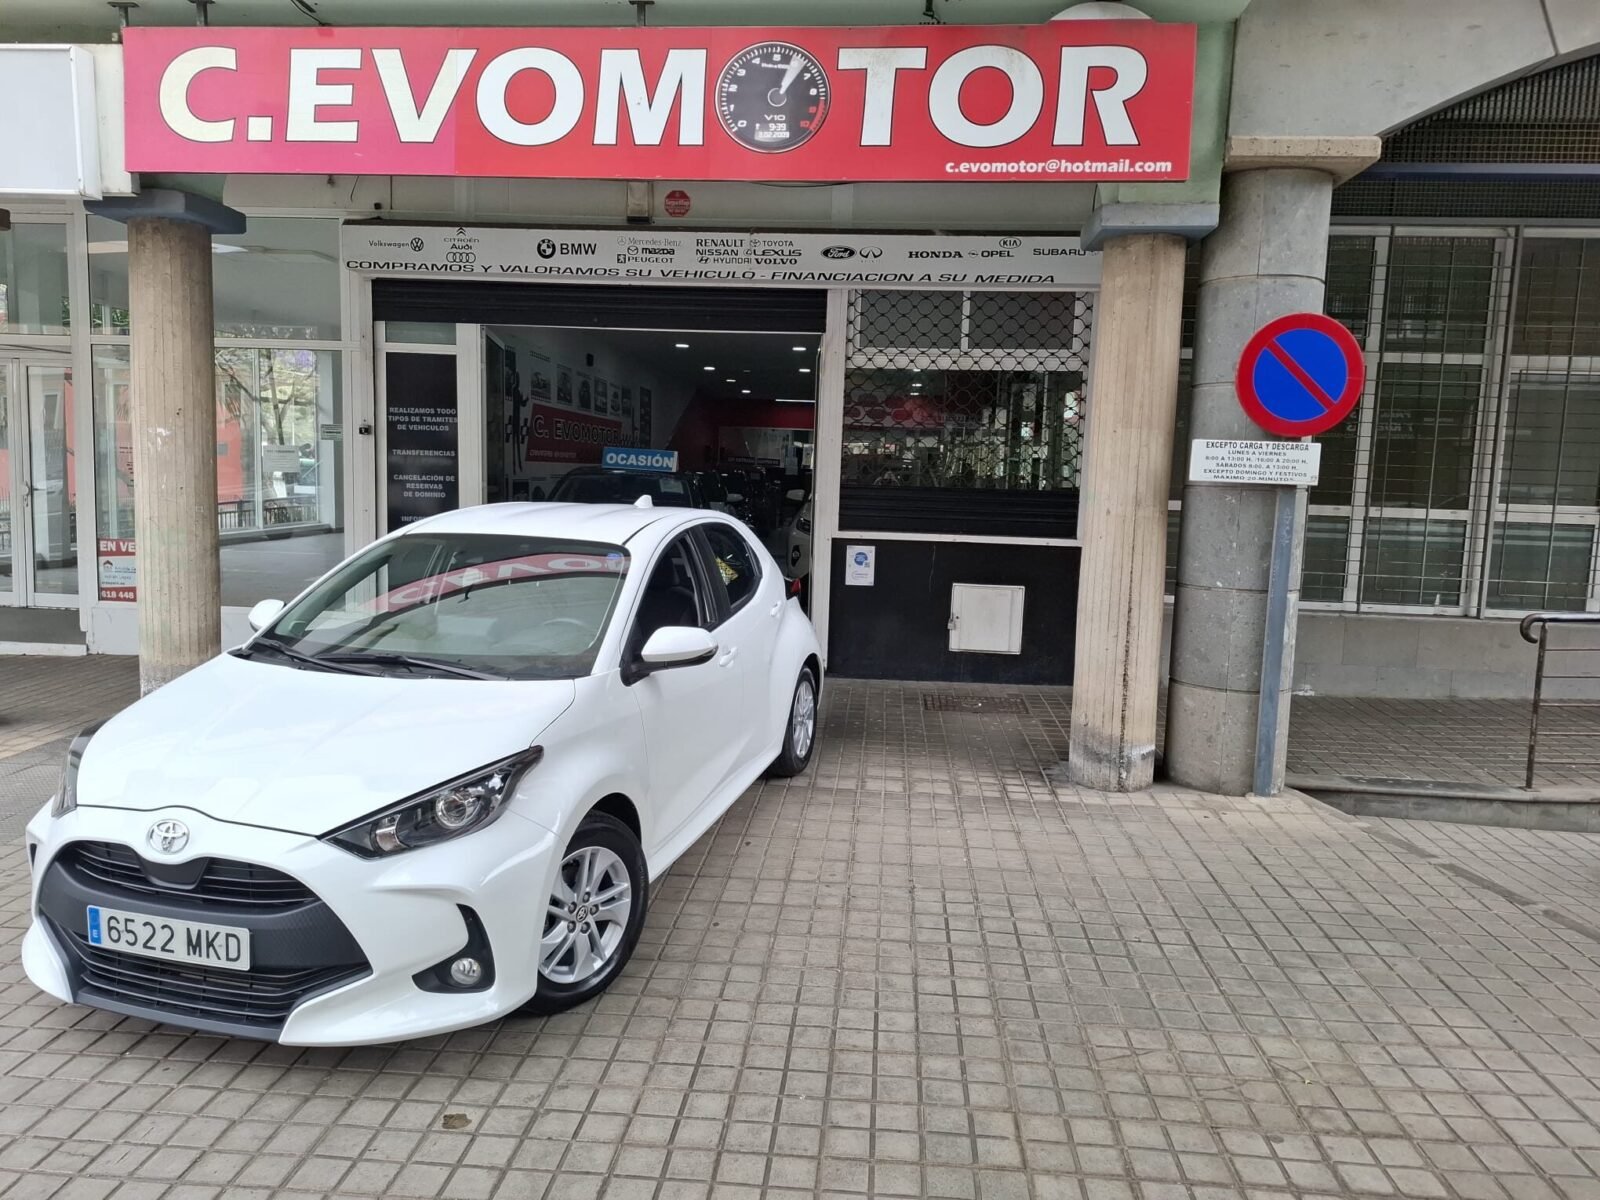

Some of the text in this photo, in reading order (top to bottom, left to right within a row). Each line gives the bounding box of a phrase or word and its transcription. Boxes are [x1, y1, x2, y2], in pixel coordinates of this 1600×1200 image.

[945, 159, 1172, 174] c.evomotor@hotmail.com
[368, 240, 410, 249] Volkswagen
[696, 238, 746, 247] RENAULT
[560, 243, 597, 255] BMW
[826, 248, 851, 259] Ford
[1033, 248, 1086, 256] SUBARU
[908, 250, 964, 259] HONDA
[346, 260, 474, 272] COMPRAMOS
[500, 264, 620, 276] VALORAMOS
[625, 268, 652, 277] SU
[660, 270, 756, 280] VEHICULO
[771, 272, 914, 282] FINANCIACION
[939, 274, 967, 282] SU
[974, 275, 1055, 283] MEDIDA
[1240, 442, 1263, 450] CARGA
[1272, 443, 1310, 451] DESCARGA
[606, 452, 674, 468] OCASIÓN
[100, 541, 116, 551] EN
[92, 929, 99, 938] E
[107, 915, 241, 963] 6522 MKD
